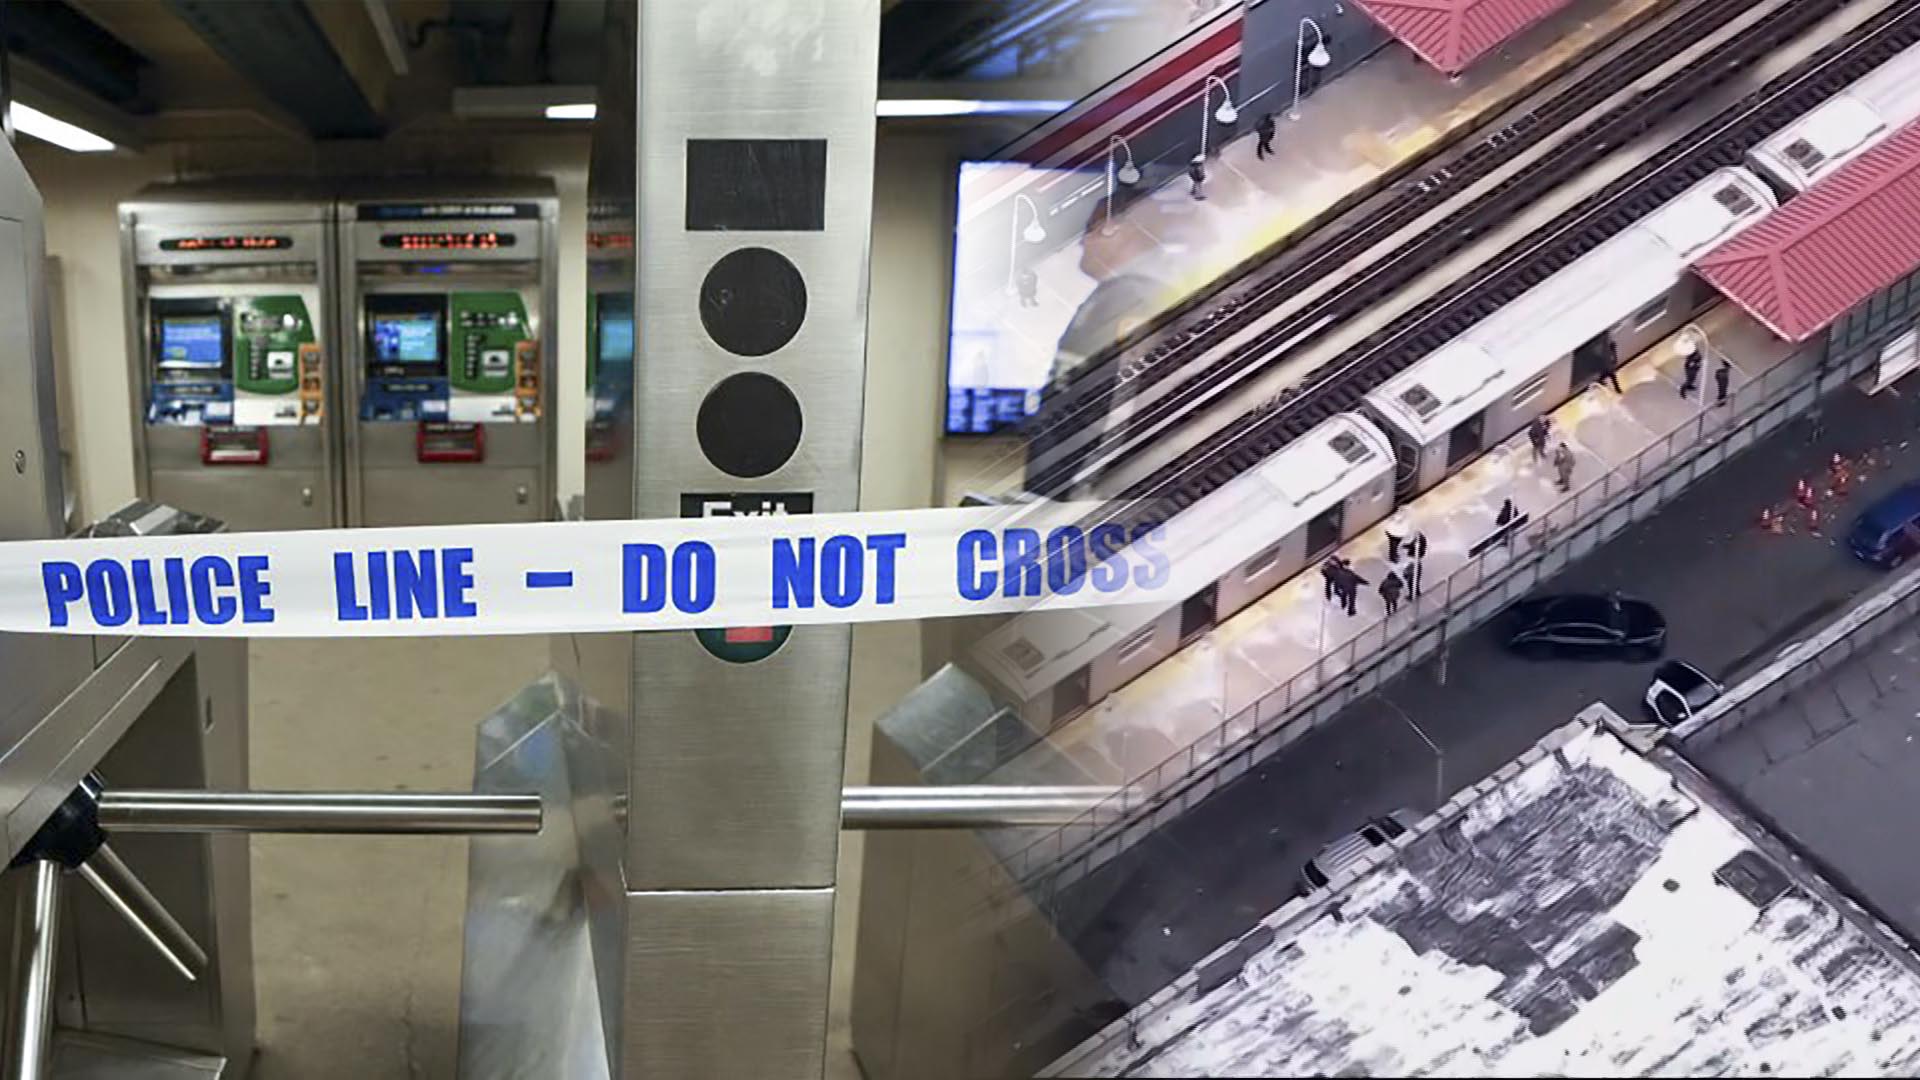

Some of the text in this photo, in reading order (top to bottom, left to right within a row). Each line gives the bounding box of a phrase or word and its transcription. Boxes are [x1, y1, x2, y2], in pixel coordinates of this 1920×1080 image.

[42, 556, 275, 627] POLICE
[334, 548, 477, 621] LINE
[623, 541, 716, 614] DO
[772, 532, 906, 609] NOT
[956, 523, 1170, 601] CROSS
